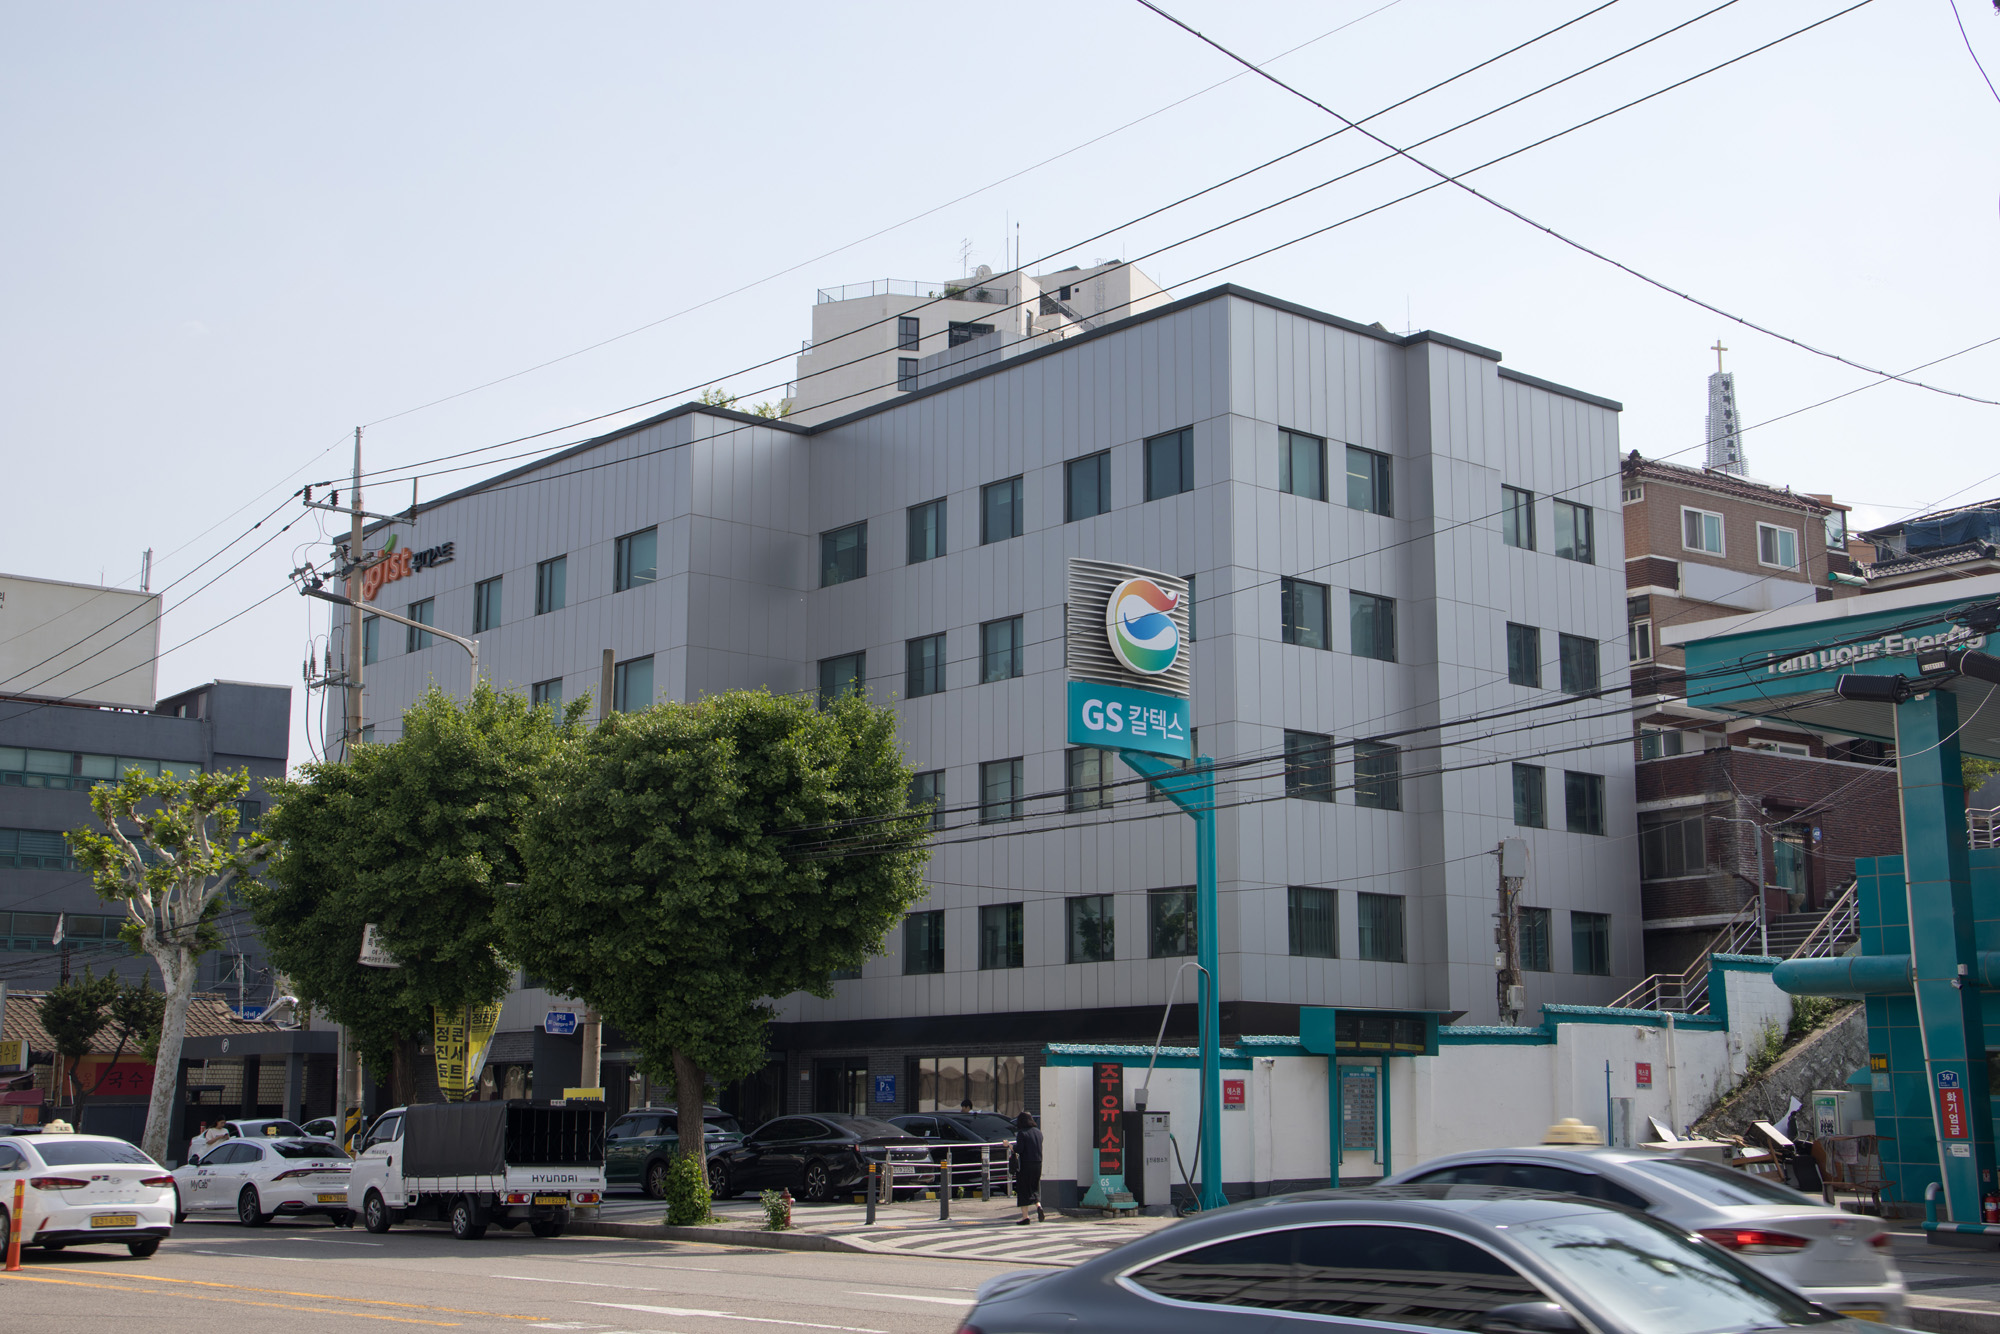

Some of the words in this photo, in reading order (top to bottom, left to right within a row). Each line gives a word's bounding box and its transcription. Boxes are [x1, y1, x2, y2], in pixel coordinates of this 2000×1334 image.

[411, 541, 455, 573] 푸디스트
[1768, 652, 1777, 674] I
[1778, 653, 1818, 673] am
[1820, 641, 1885, 672] your
[1082, 699, 1124, 733] GS
[1128, 705, 1184, 740] 칼텍스
[450, 1027, 463, 1079] 콘서트
[108, 1070, 155, 1089] 국수
[1941, 1073, 1954, 1081] 367
[1100, 1064, 1121, 1153] 주유소
[1946, 1091, 1961, 1136] 화기엄금
[532, 1174, 578, 1183] HYUNDAI
[1100, 1178, 1110, 1187] GS
